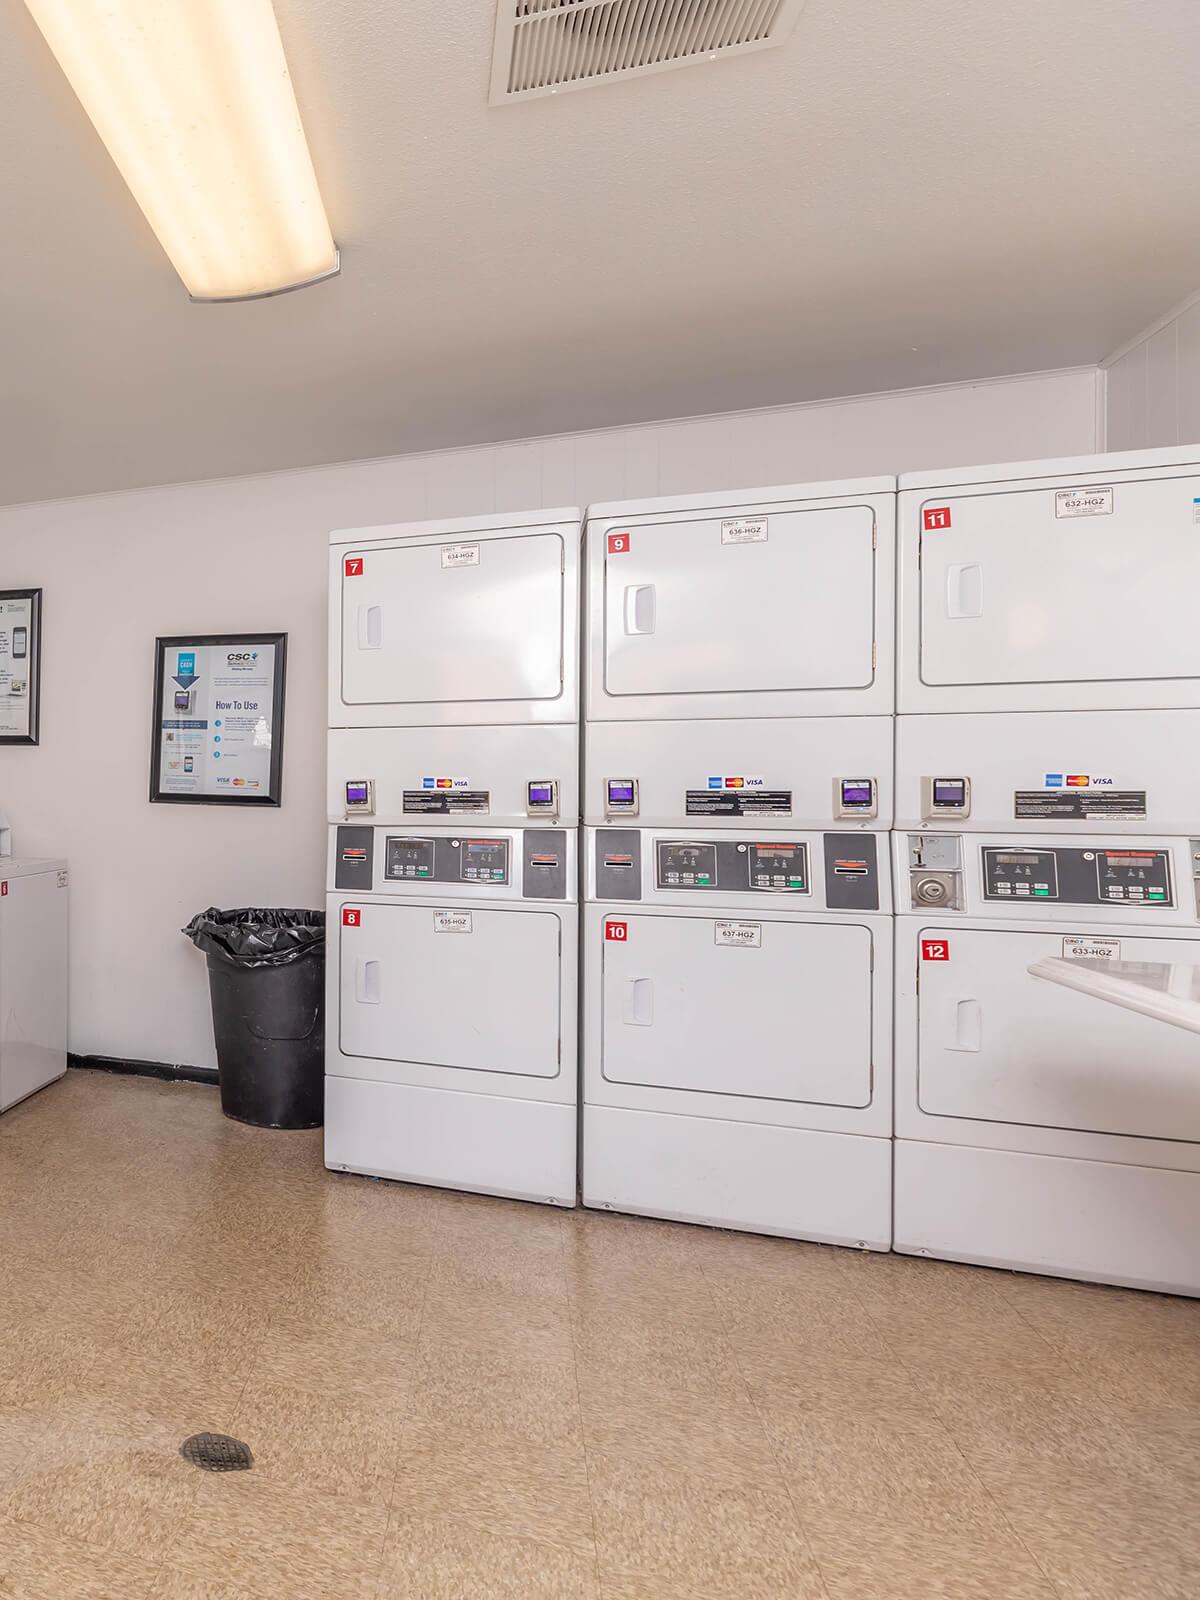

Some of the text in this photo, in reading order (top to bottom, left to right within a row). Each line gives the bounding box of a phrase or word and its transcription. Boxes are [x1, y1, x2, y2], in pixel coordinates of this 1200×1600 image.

[928, 513, 945, 527] 11
[614, 539, 624, 551] 9
[350, 563, 358, 574] 7
[227, 653, 251, 661] CSC
[215, 700, 258, 710] How To Use
[347, 913, 356, 924] 8
[608, 926, 625, 938] 10
[925, 945, 945, 958] 12
